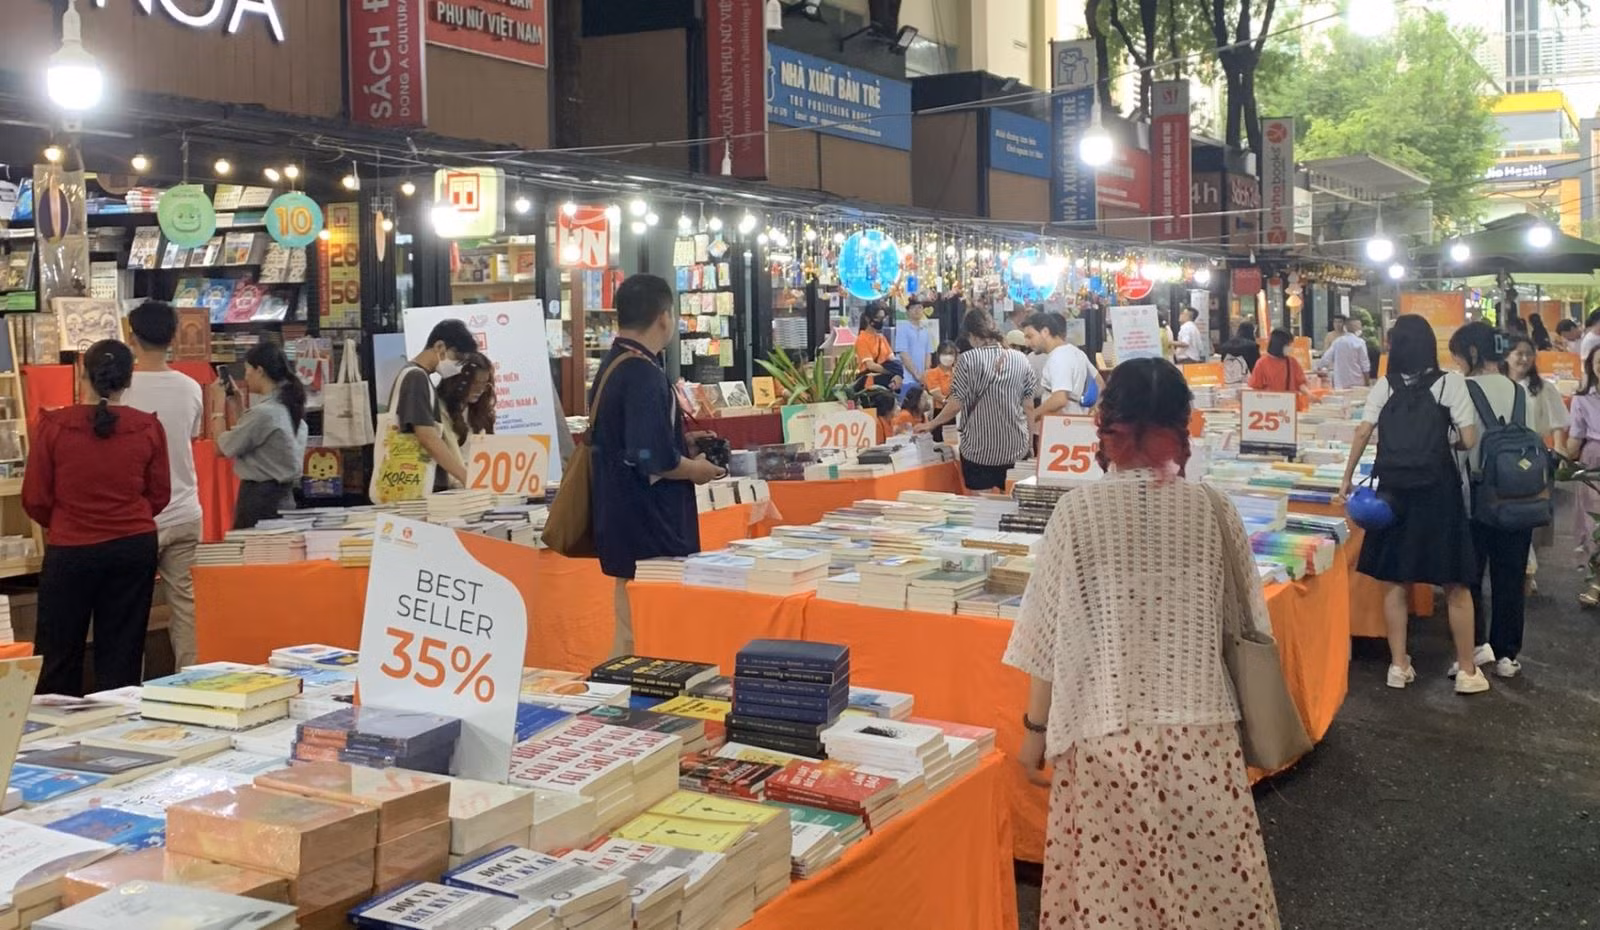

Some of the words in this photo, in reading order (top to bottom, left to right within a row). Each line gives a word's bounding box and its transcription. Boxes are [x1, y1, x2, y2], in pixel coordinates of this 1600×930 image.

[437, 3, 464, 31] PHỤ
[488, 12, 514, 41] VIỆT
[516, 21, 543, 44] NAM
[363, 25, 392, 119] SÁCH
[781, 60, 805, 90] NHÀ
[808, 66, 836, 97] XUẤT
[838, 71, 860, 103] BẢN
[862, 79, 881, 109] TRẺ
[399, 73, 410, 117] DONG
[274, 207, 312, 236] 10
[331, 280, 359, 305] 50
[819, 422, 870, 448] 20%
[1248, 409, 1290, 431] 25%
[382, 471, 420, 487] KOREA
[471, 451, 541, 494] 20%
[416, 569, 483, 605] BEST
[397, 594, 494, 639] SELLER
[380, 626, 495, 703] 35%
